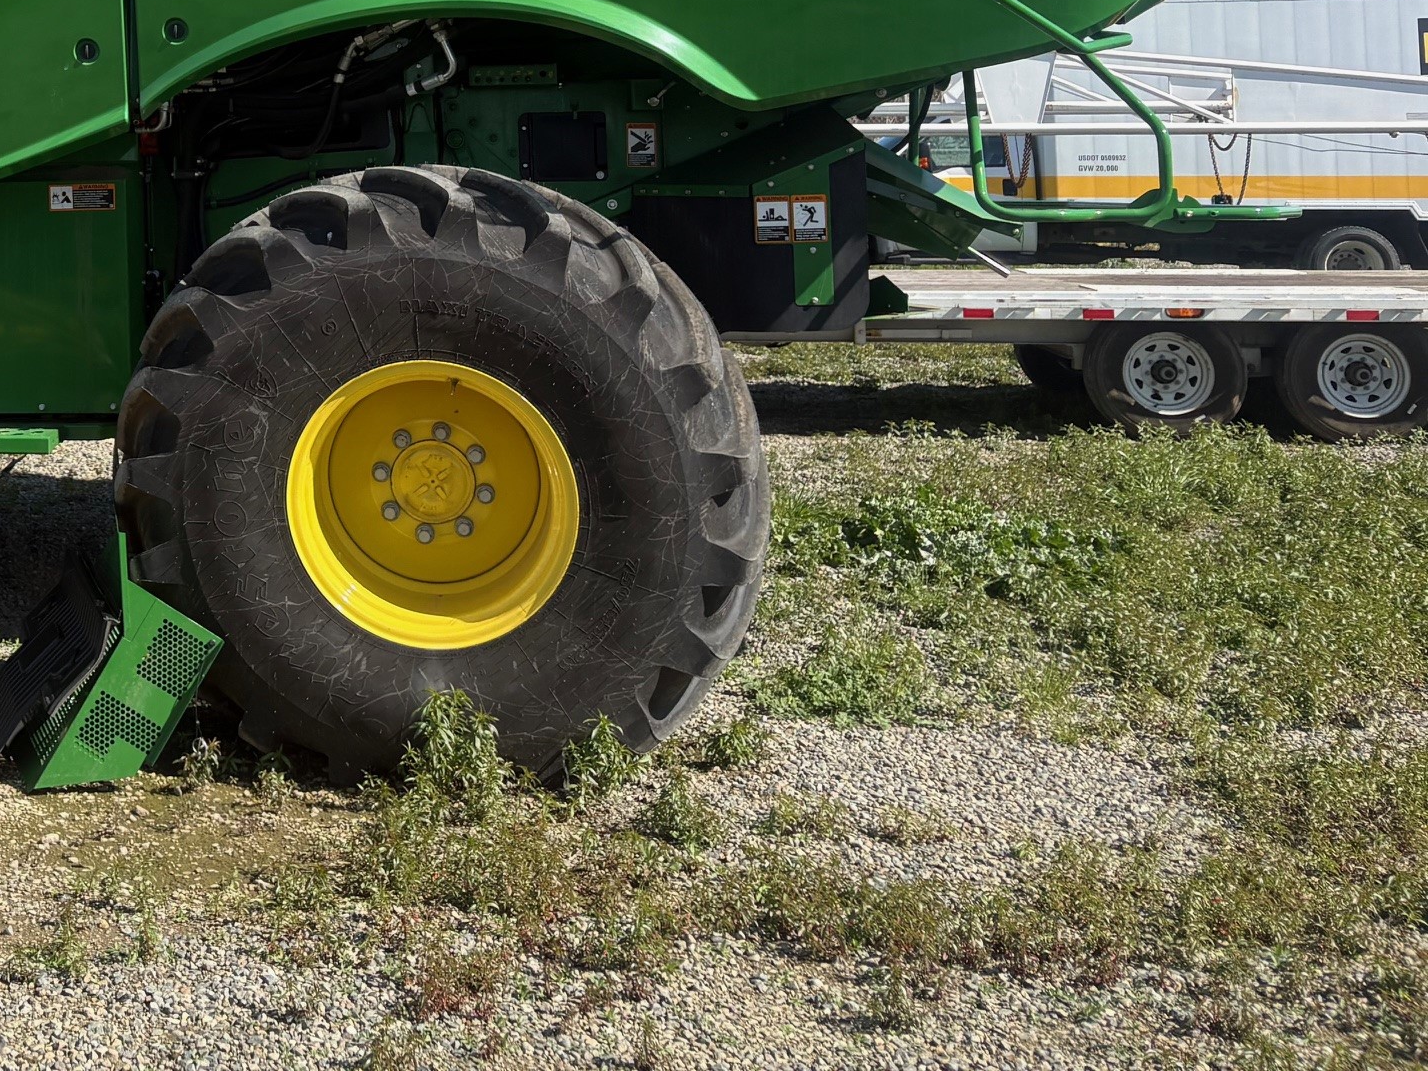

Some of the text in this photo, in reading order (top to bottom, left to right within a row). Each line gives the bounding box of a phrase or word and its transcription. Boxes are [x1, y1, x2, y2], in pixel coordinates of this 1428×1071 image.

[1078, 154, 1099, 162] USDOT
[1078, 164, 1119, 172] GVW 20,000
